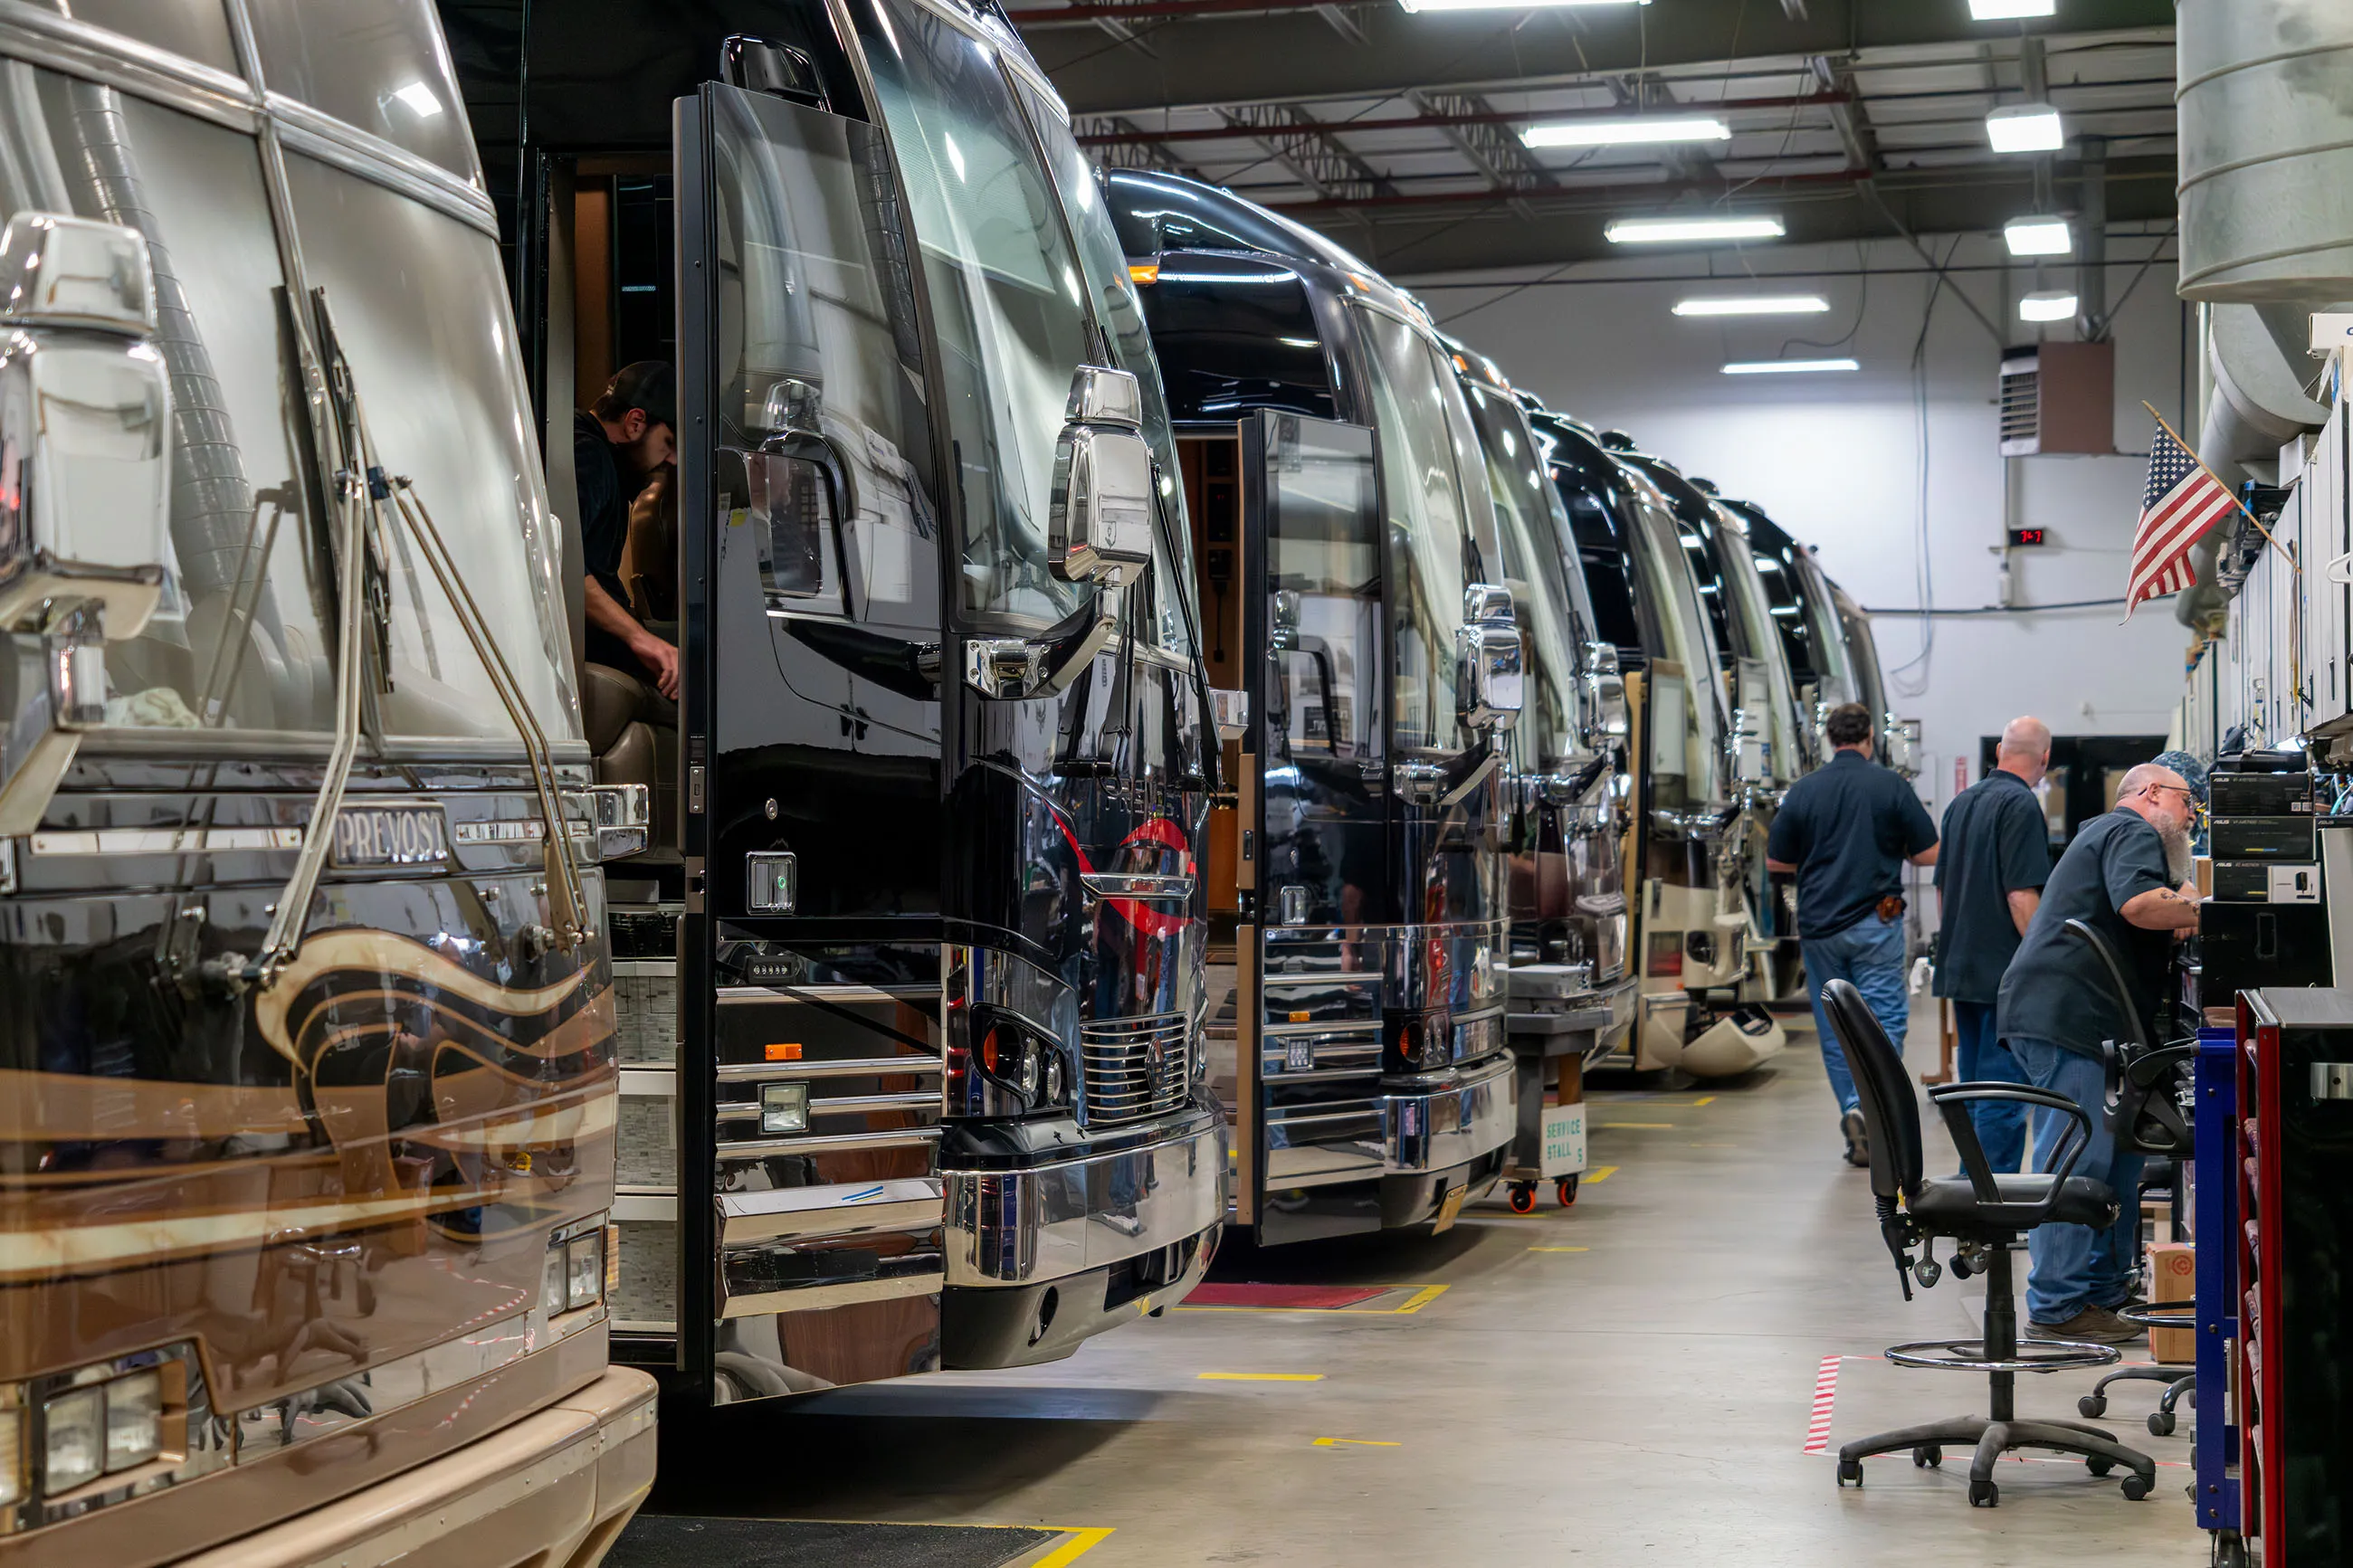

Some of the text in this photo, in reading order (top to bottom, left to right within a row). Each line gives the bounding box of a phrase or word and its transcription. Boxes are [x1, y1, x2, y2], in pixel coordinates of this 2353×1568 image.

[337, 810, 447, 859] PREVOST
[1547, 1118, 1581, 1138] SERVICE
[1547, 1142, 1571, 1160] STALL
